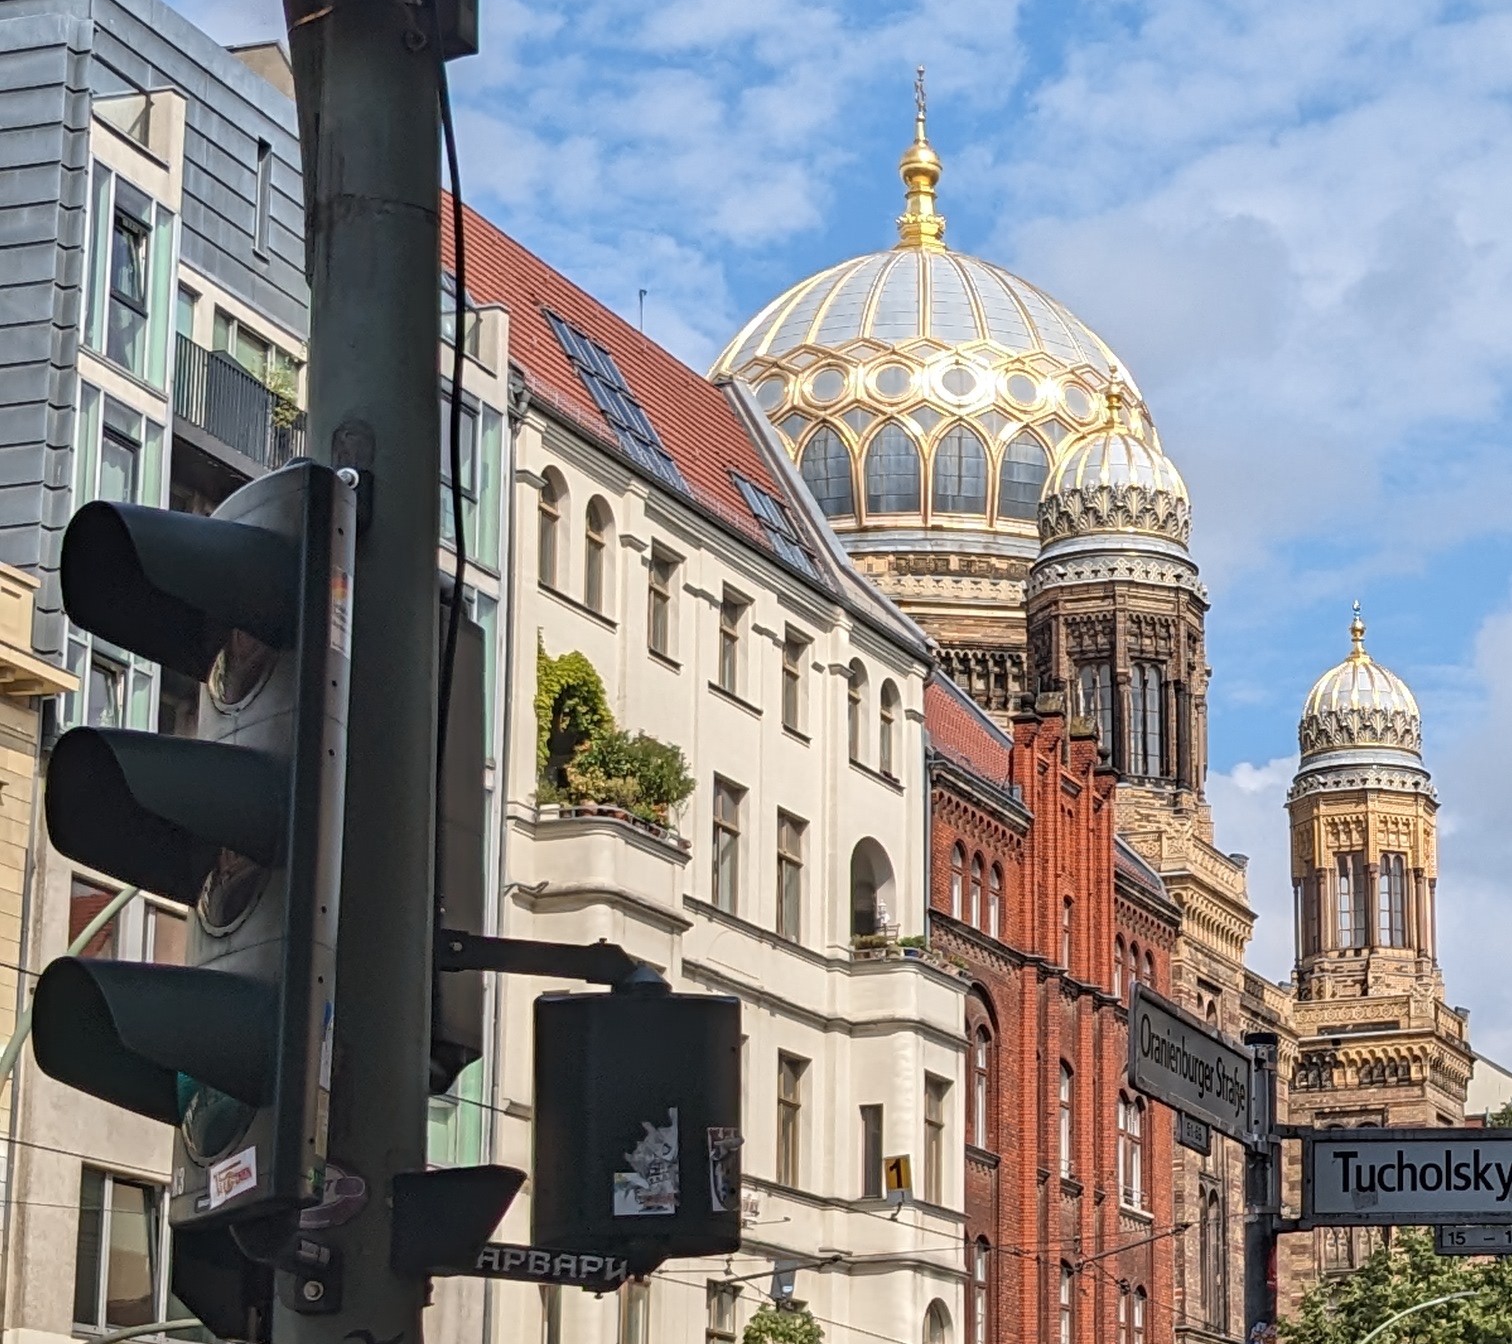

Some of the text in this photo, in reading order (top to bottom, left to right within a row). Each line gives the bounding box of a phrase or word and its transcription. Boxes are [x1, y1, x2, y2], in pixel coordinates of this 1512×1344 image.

[1140, 1013, 1246, 1118] Oranienburger Straße
[889, 1158, 903, 1189] 1
[1448, 1231, 1466, 1246] 15
